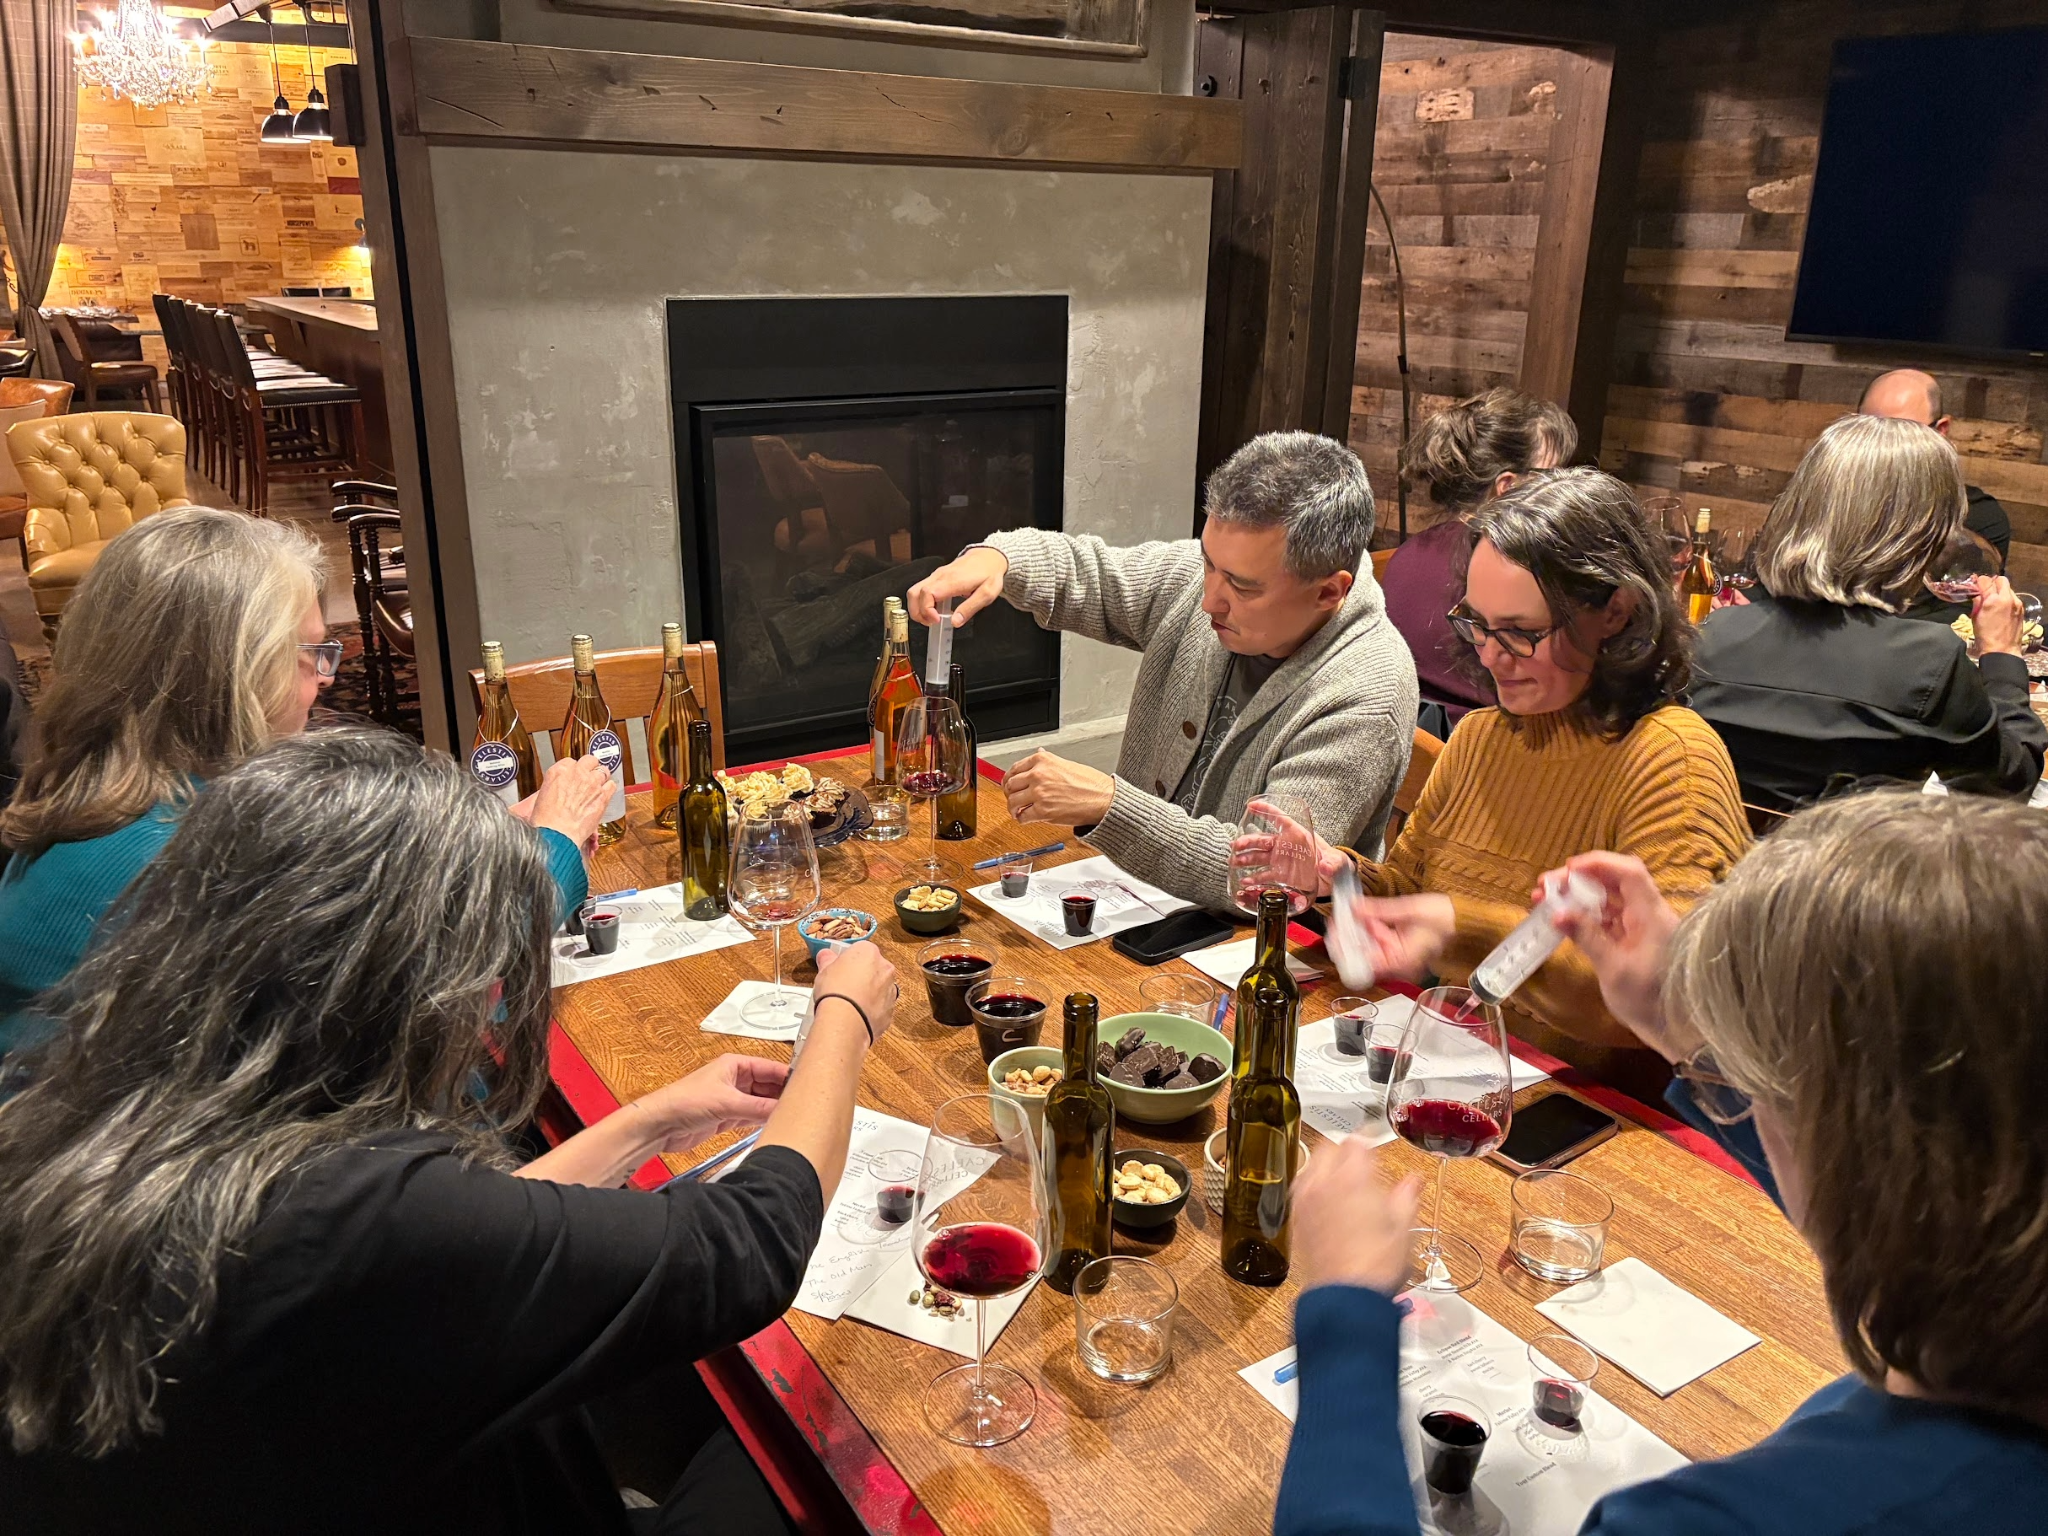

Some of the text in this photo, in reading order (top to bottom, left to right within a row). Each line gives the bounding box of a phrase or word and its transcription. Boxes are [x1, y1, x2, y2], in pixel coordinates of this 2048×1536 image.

[1309, 1105, 1353, 1133] CAELESTIS
[1462, 1109, 1503, 1123] CELLARS
[830, 1269, 847, 1280] Old
[1496, 1407, 1513, 1417] Merlot
